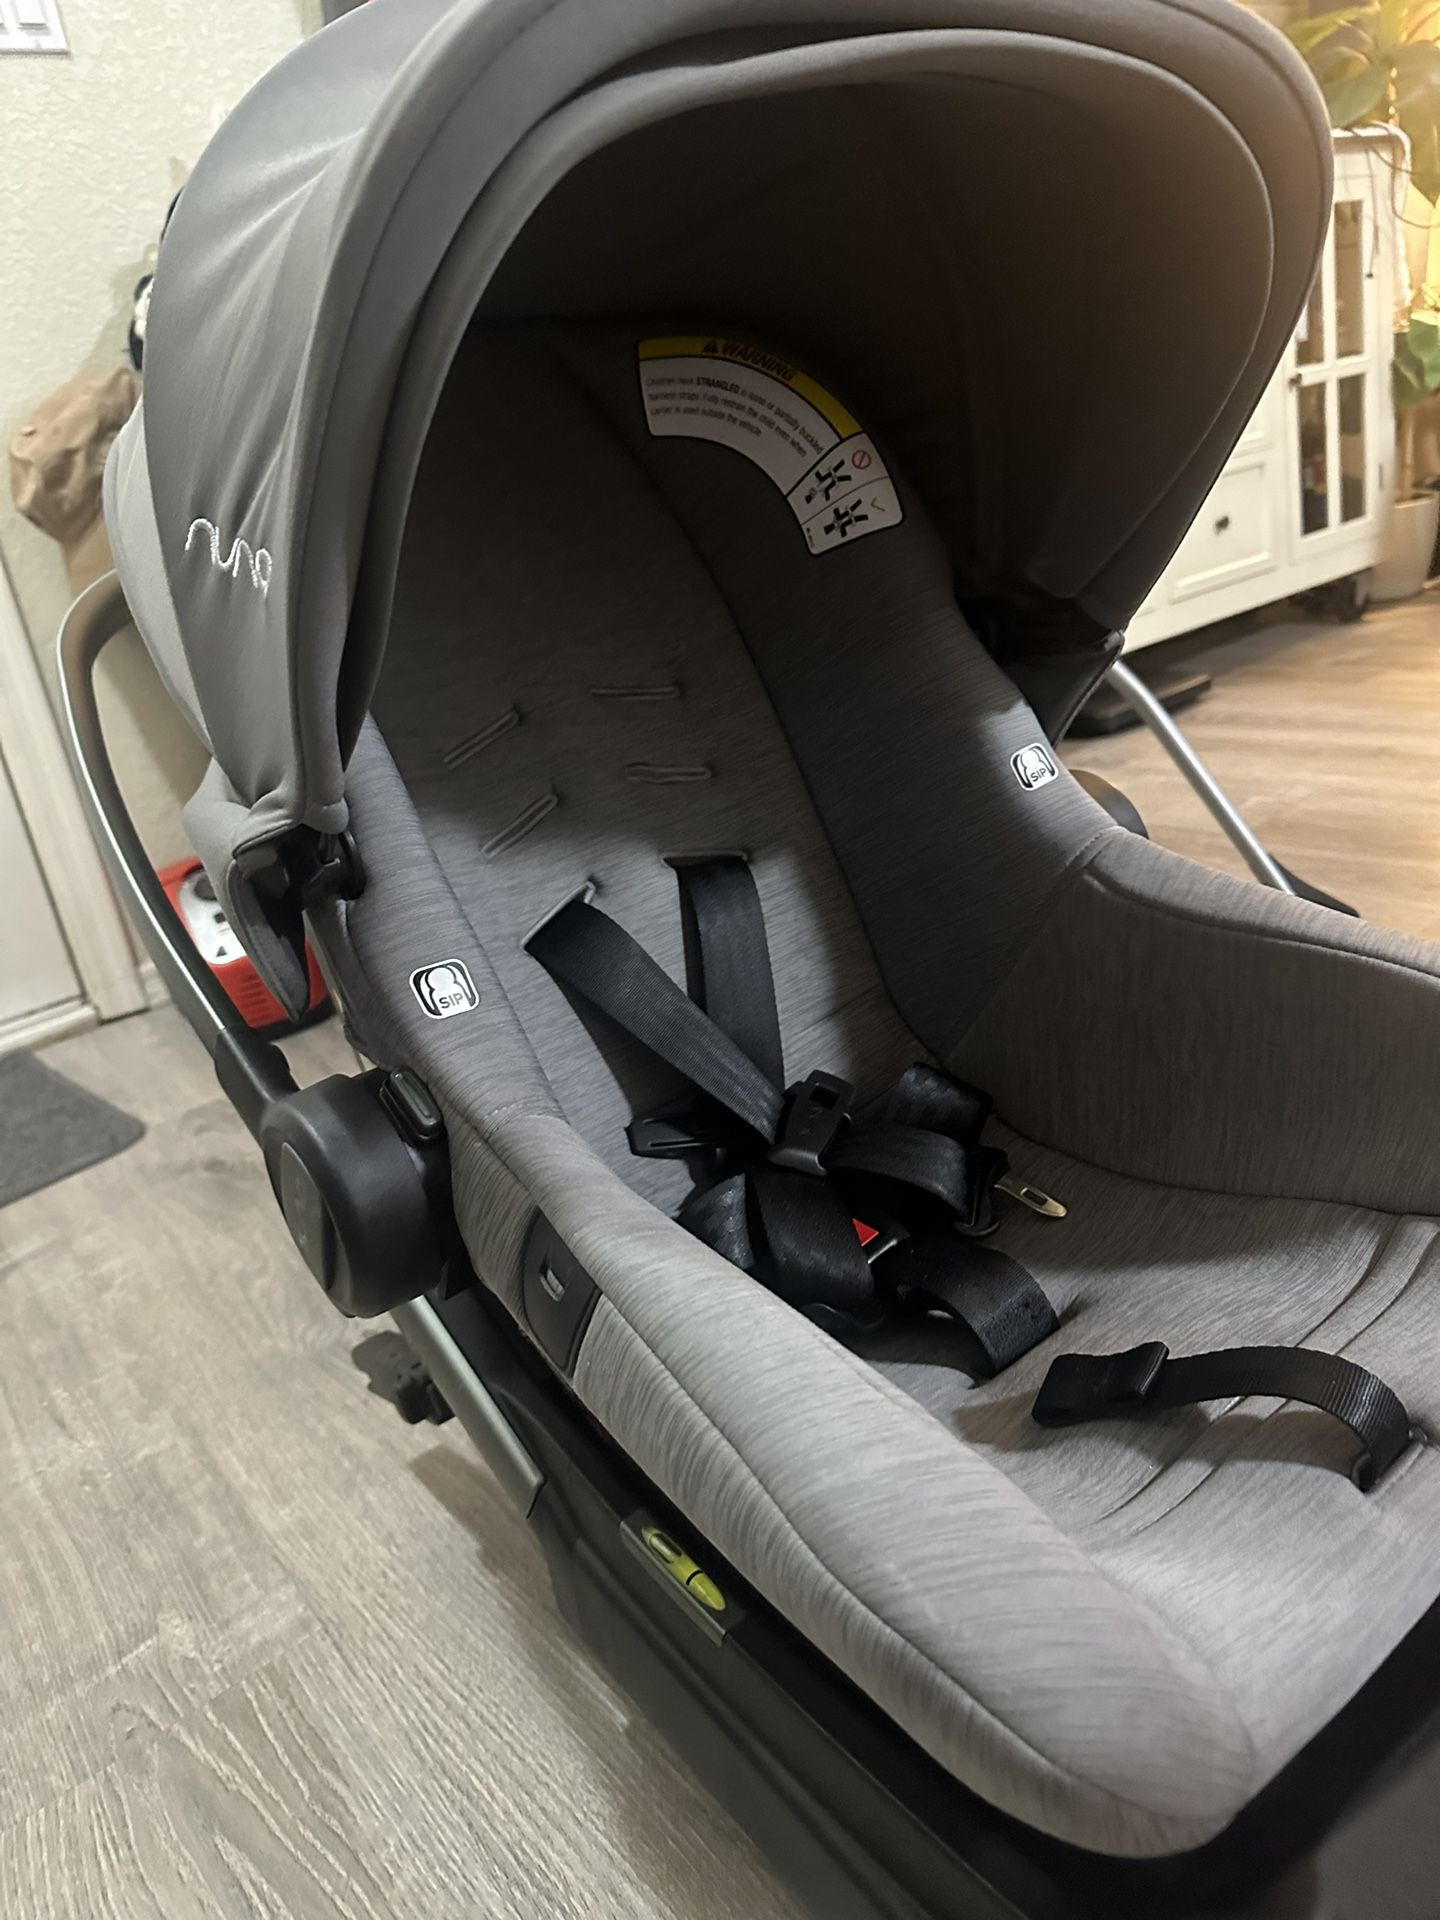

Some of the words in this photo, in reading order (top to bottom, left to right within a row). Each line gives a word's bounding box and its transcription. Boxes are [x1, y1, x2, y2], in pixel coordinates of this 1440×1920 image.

[722, 343, 796, 382] WARNING
[696, 376, 740, 394] STRANGLED
[1030, 767, 1047, 782] SIP
[439, 992, 464, 1009] SIP
